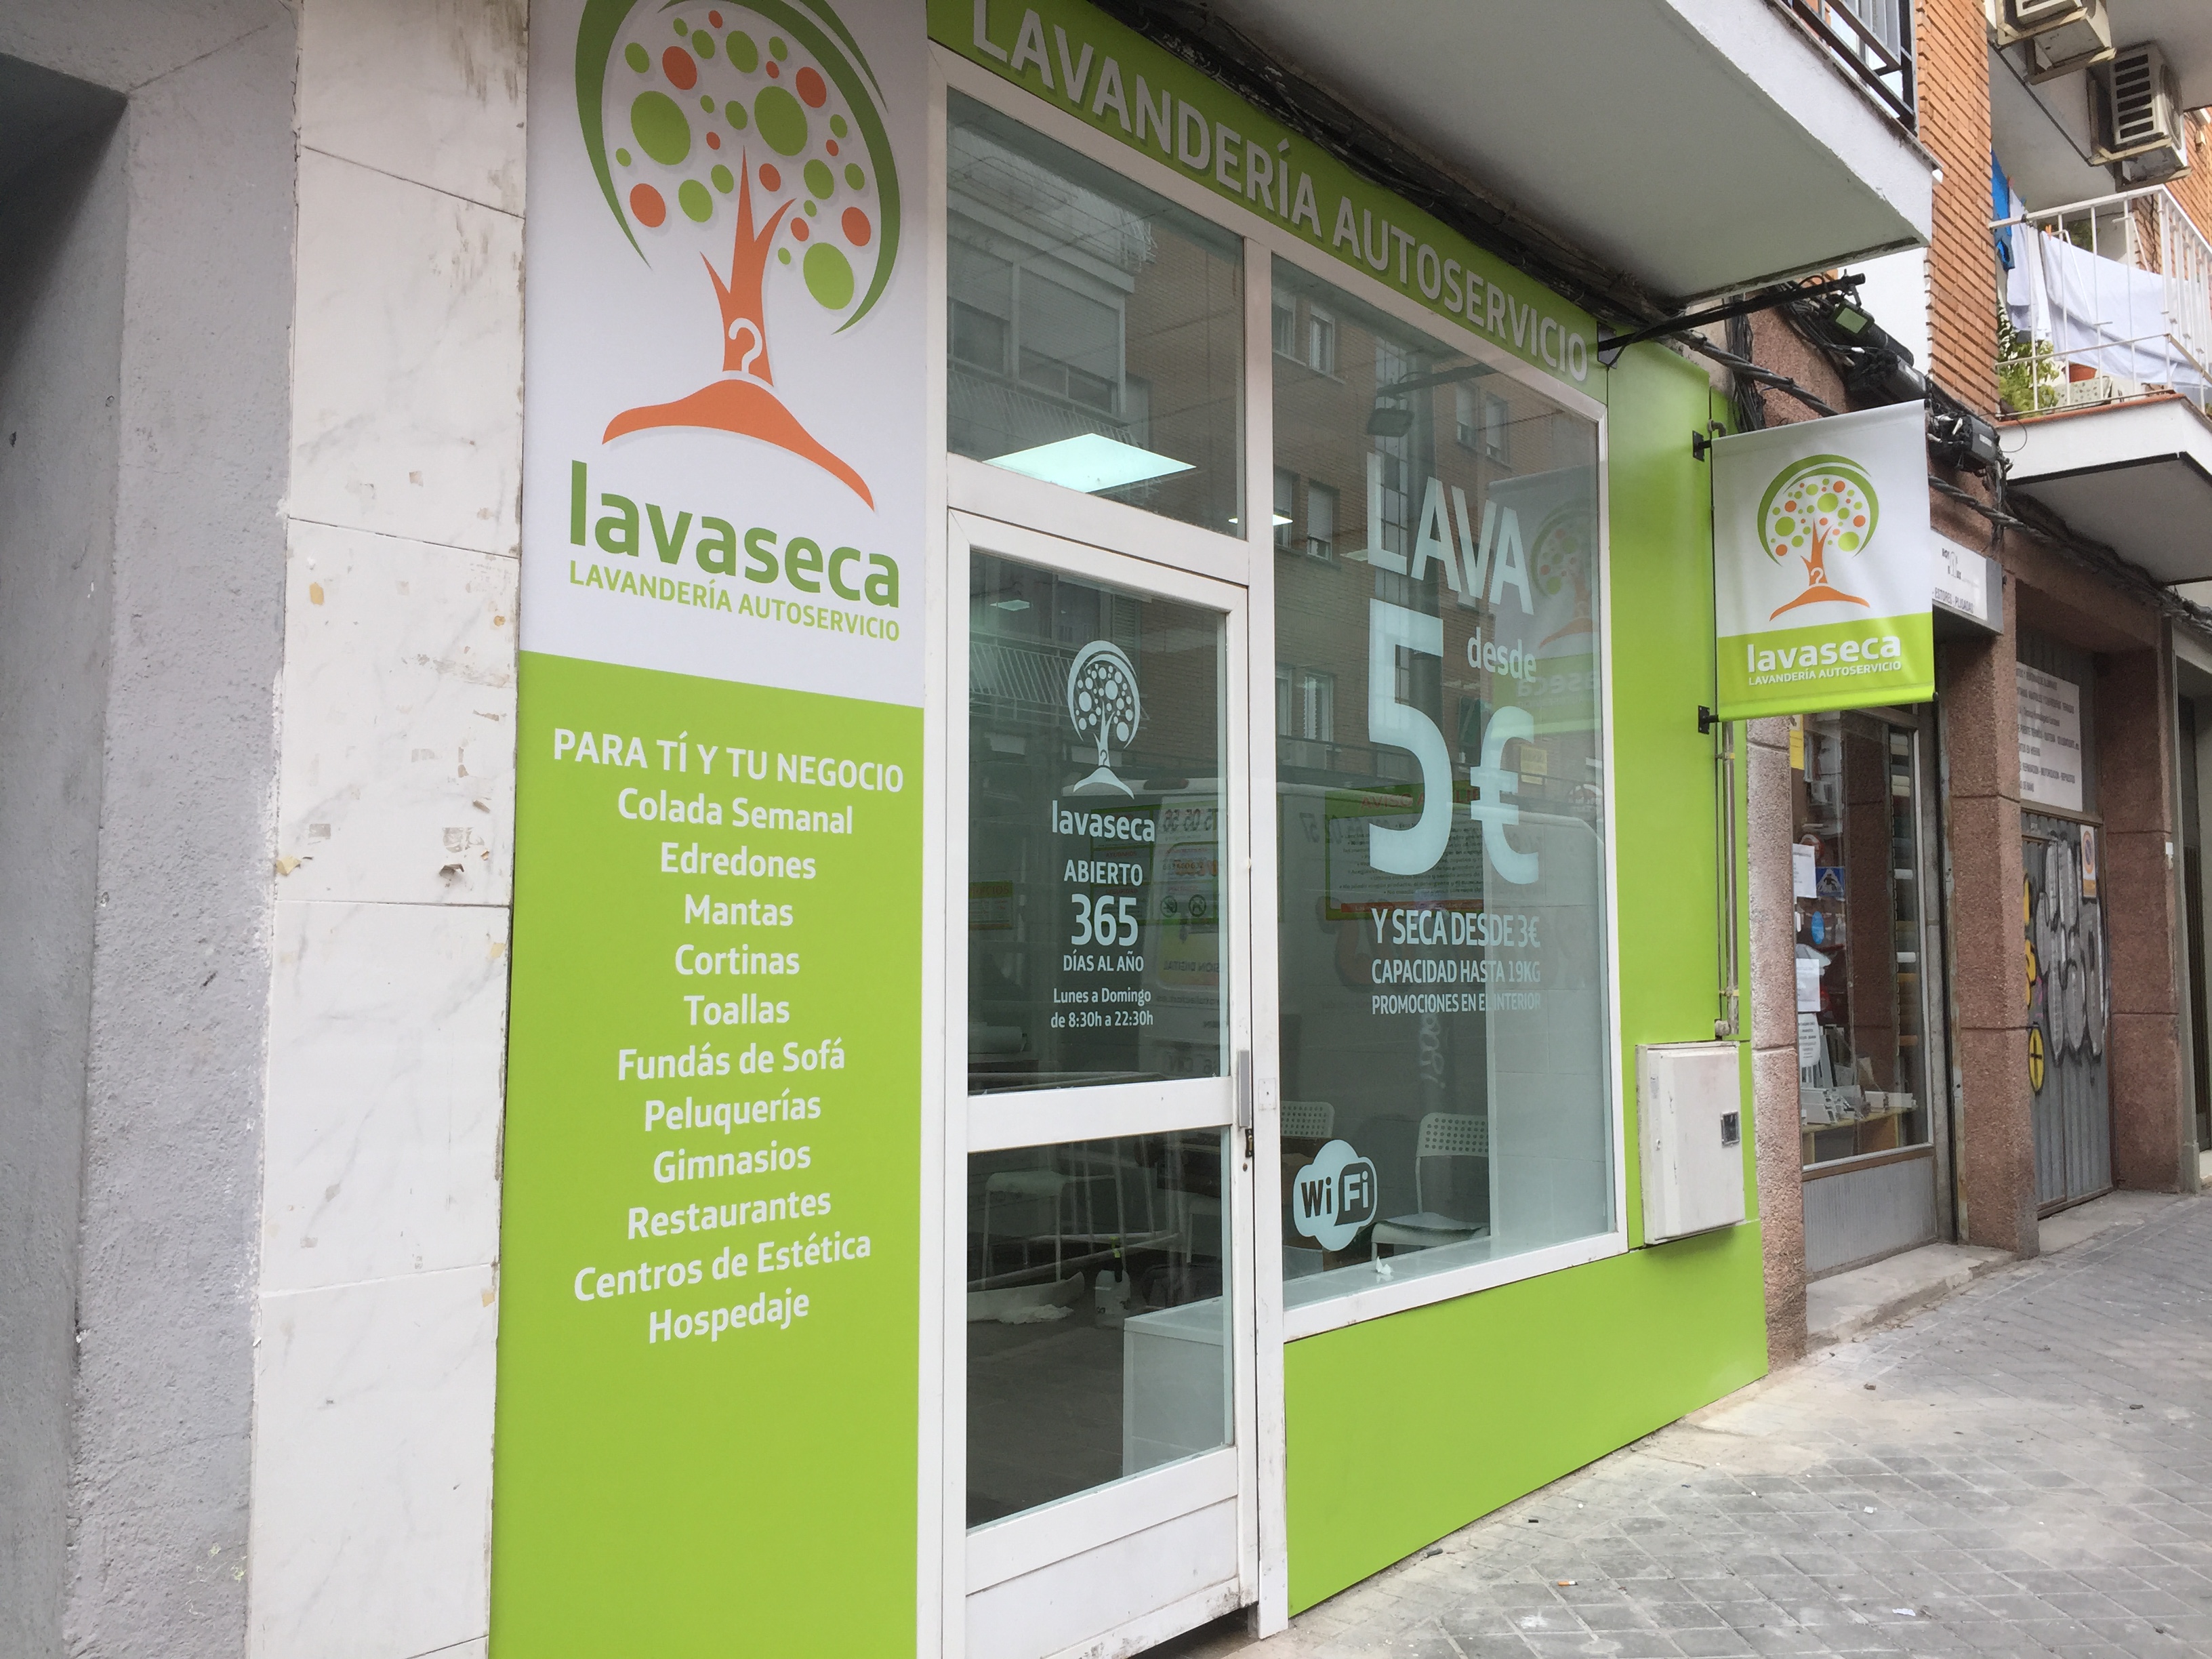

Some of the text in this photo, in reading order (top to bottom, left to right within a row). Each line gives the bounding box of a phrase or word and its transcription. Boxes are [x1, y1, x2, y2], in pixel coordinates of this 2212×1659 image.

[972, 0, 1589, 383] LAVANDERÍA AUTOSERVICIO
[569, 459, 900, 609] lavaseca
[1367, 451, 1534, 615] LAVA
[569, 560, 900, 641] LAVANDERÍA AUTOSERVICIO
[1467, 626, 1537, 683] desde
[1746, 634, 1902, 673] lavaseca
[1748, 661, 1902, 686] LAVANDERÍA AUTOSERVICIO
[554, 728, 904, 793] PARA TÍ Y TU NEGOCIO
[618, 787, 853, 834] Colada Semanal
[1052, 800, 1155, 842] lavaseca
[661, 842, 817, 880] Edredones
[1064, 859, 1143, 886] ABIERTO
[684, 894, 794, 926] Mantas
[1071, 895, 1139, 946] 365
[1370, 908, 1541, 948] Y SECA DESDE 3€
[675, 944, 800, 975] Cortinas
[1063, 949, 1144, 972] DÍAS AL AÑO
[1372, 959, 1541, 984] CAPACIDAD HASTA 19KG
[683, 993, 790, 1025] Toallas
[1053, 987, 1151, 1006] Lunes a Domingo
[1372, 991, 1542, 1015] PROMOCIONES EN EL INTERIOR
[1050, 1011, 1153, 1028] de 8:30h a 22:30h
[618, 1038, 845, 1080] Fundás de Sofá
[644, 1088, 821, 1134] Peluquerías
[653, 1140, 811, 1183] Gimnasios
[628, 1191, 831, 1240] Restaurantes
[574, 1231, 871, 1301] Centros de Estética
[649, 1288, 809, 1343] Hospedaje
